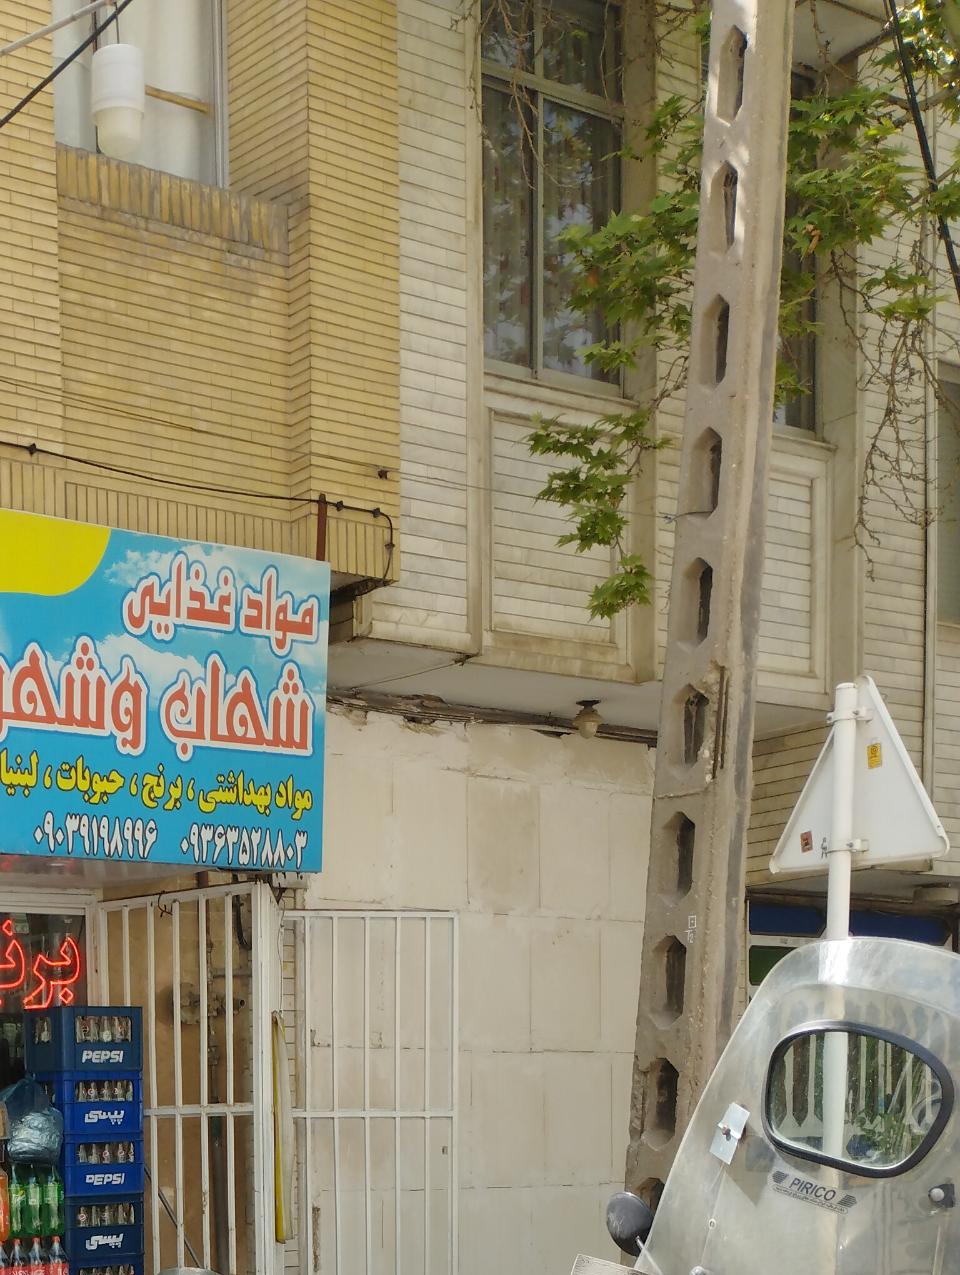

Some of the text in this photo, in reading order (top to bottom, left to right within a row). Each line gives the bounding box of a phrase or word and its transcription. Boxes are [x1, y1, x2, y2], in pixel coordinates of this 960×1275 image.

[125, 555, 318, 655] مواد غذایی
[160, 656, 314, 759] شهاب
[275, 774, 313, 821] مواد
[32, 810, 309, 870] ۰۹۳۶۳۵۲۸۸۰۳ ۰۹۰۳۹۱۹۸۹۹۶
[81, 1049, 125, 1064] PEPSI
[84, 1109, 126, 1126] پپسی
[789, 1177, 837, 1202] PIRICO
